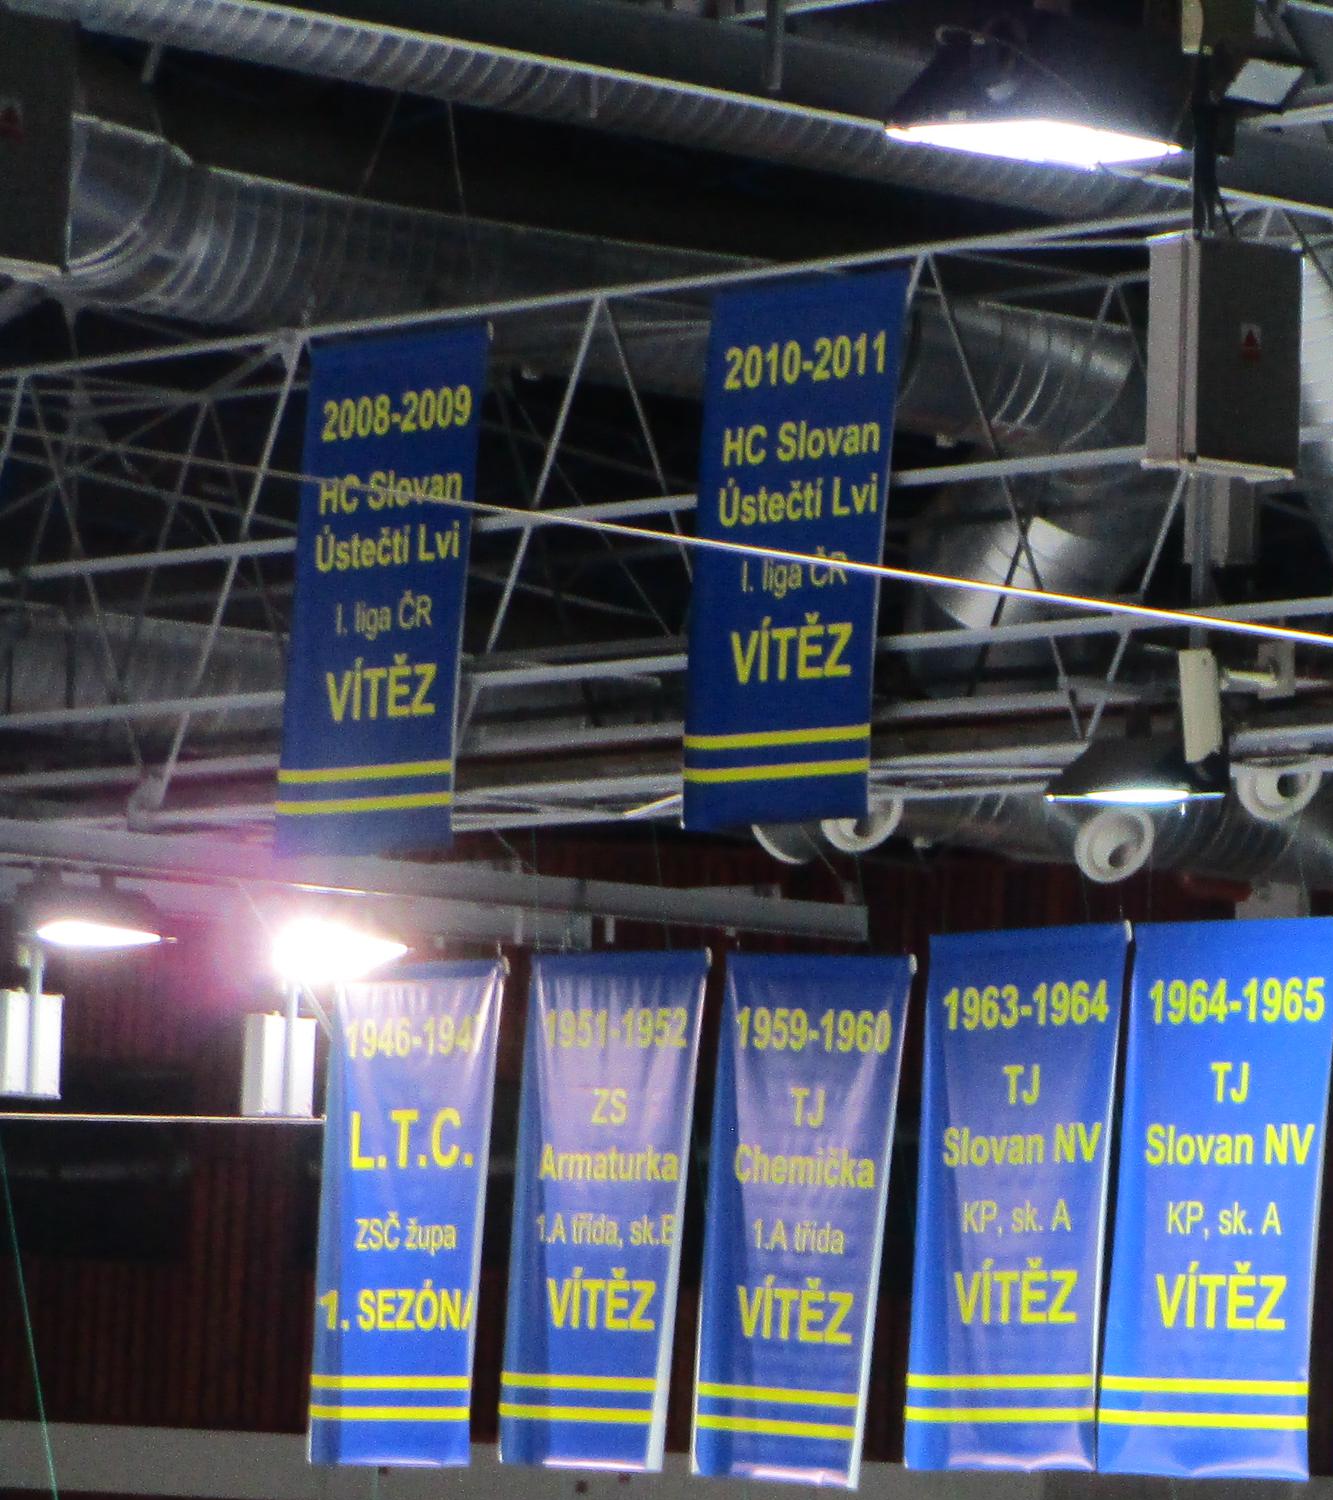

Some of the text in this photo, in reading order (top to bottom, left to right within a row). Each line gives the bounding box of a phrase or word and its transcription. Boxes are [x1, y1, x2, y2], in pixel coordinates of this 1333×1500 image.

[724, 331, 886, 390] 2010-2011
[321, 385, 473, 442] 2008-2009
[723, 422, 880, 467] HC Slovan
[318, 469, 464, 516] HC Slovan
[719, 473, 878, 527] Ústečtí Lvi
[316, 521, 460, 572] Ústečtí Lvi
[355, 602, 392, 640] liga
[398, 590, 432, 629] ČR
[731, 613, 853, 684] VÍTĚZ
[327, 654, 437, 721] VÍTĚZ
[944, 981, 1109, 1030] 1963-1964
[1150, 977, 1325, 1024] 1964-1965
[345, 1012, 482, 1060] 1946-194
[544, 1008, 687, 1049] 1951-1952
[736, 1008, 891, 1053] 1959-1960
[1003, 1065, 1040, 1105] TJ
[1211, 1062, 1250, 1103] TJ
[591, 1088, 628, 1125] ZS
[791, 1087, 826, 1127] TJ
[350, 1107, 474, 1170] L.T.C.
[944, 1123, 1102, 1166] Slovan NV
[1146, 1124, 1315, 1165] Slovan NV
[540, 1145, 681, 1182] Armaturka
[735, 1144, 876, 1189] Chemička
[355, 1211, 458, 1259] ZSČ župa
[963, 1199, 1072, 1233] KP, sk. A
[1167, 1200, 1282, 1237] KP, sk. A
[319, 1288, 350, 1332] 1.
[548, 1268, 656, 1331] VÍTĚZ
[739, 1276, 854, 1344] VÍTĚZ
[955, 1258, 1078, 1323] VÍTĚZ
[1156, 1261, 1287, 1330] VÍTĚZ
